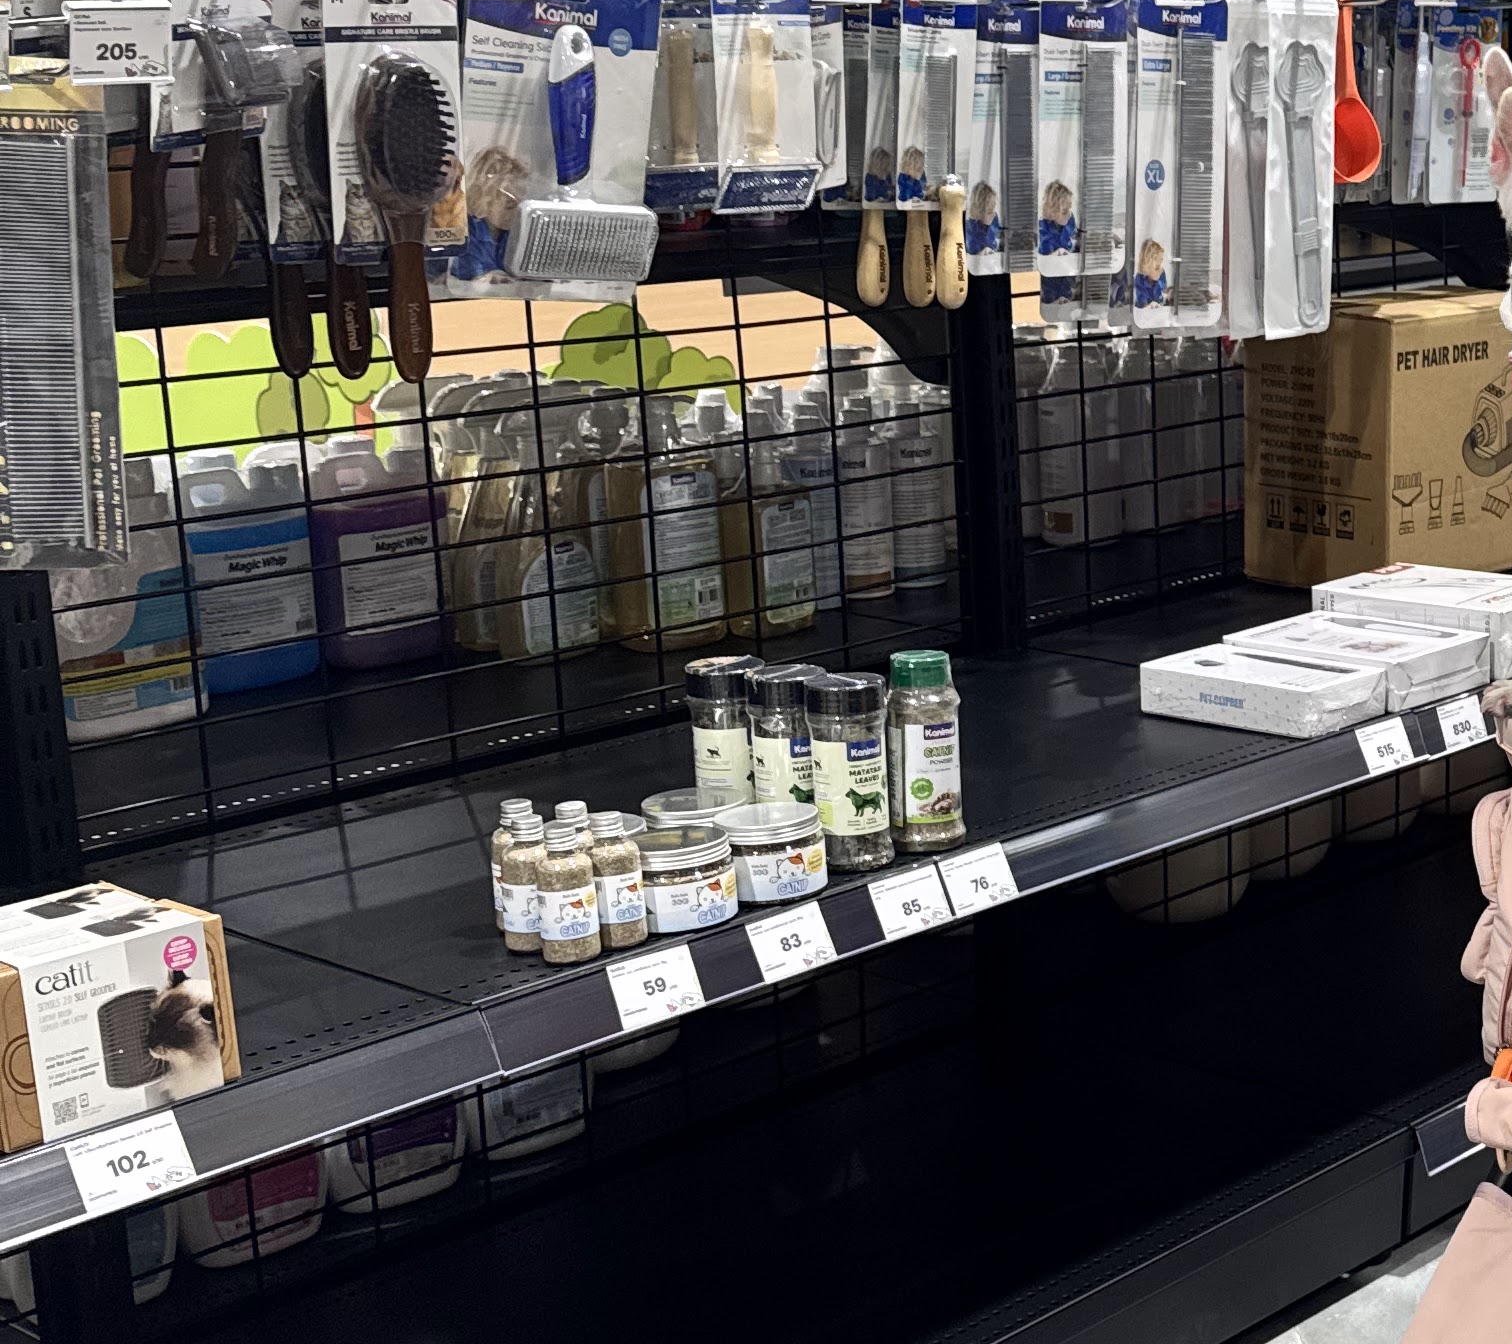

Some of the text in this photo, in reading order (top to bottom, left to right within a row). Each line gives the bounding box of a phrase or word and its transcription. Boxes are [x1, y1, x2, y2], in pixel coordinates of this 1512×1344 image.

[370, 10, 413, 25] Kanimal
[534, 1, 598, 28] Kanimal
[923, 13, 956, 28] Kanimal
[1066, 14, 1106, 30] Kanimal
[1161, 8, 1203, 25] Kanimal
[987, 17, 1023, 33] Kanimal
[95, 42, 138, 61] 205
[471, 34, 534, 54] Self Cleaning
[0, 116, 80, 134] ROOMING
[1146, 168, 1164, 184] XL
[876, 244, 888, 284] Kanimal
[922, 243, 934, 284] Kanimal
[955, 241, 966, 284] Kanimal
[343, 300, 363, 352] Kanimal
[407, 302, 425, 355] Kanimal
[1396, 340, 1490, 372] PET HAIR DRYER
[374, 535, 429, 554] Magic Whip
[227, 554, 288, 574] Magic Whip
[924, 726, 955, 739] Kanimal
[1452, 719, 1472, 736] 830
[850, 746, 882, 759] Kanimal
[923, 744, 955, 758] CATNIP
[1376, 742, 1395, 758] 515
[854, 774, 880, 786] LEAVES
[776, 877, 809, 897] CATNIP
[969, 876, 990, 894] 76
[616, 903, 644, 921] CATNIP
[697, 903, 727, 924] CATNIP
[901, 898, 922, 916] 85
[559, 922, 591, 938] CATNIP
[779, 933, 802, 952] 83
[35, 960, 94, 996] catit
[642, 976, 667, 996] 59
[73, 990, 88, 1003] SELF
[106, 1150, 151, 1178] 102
